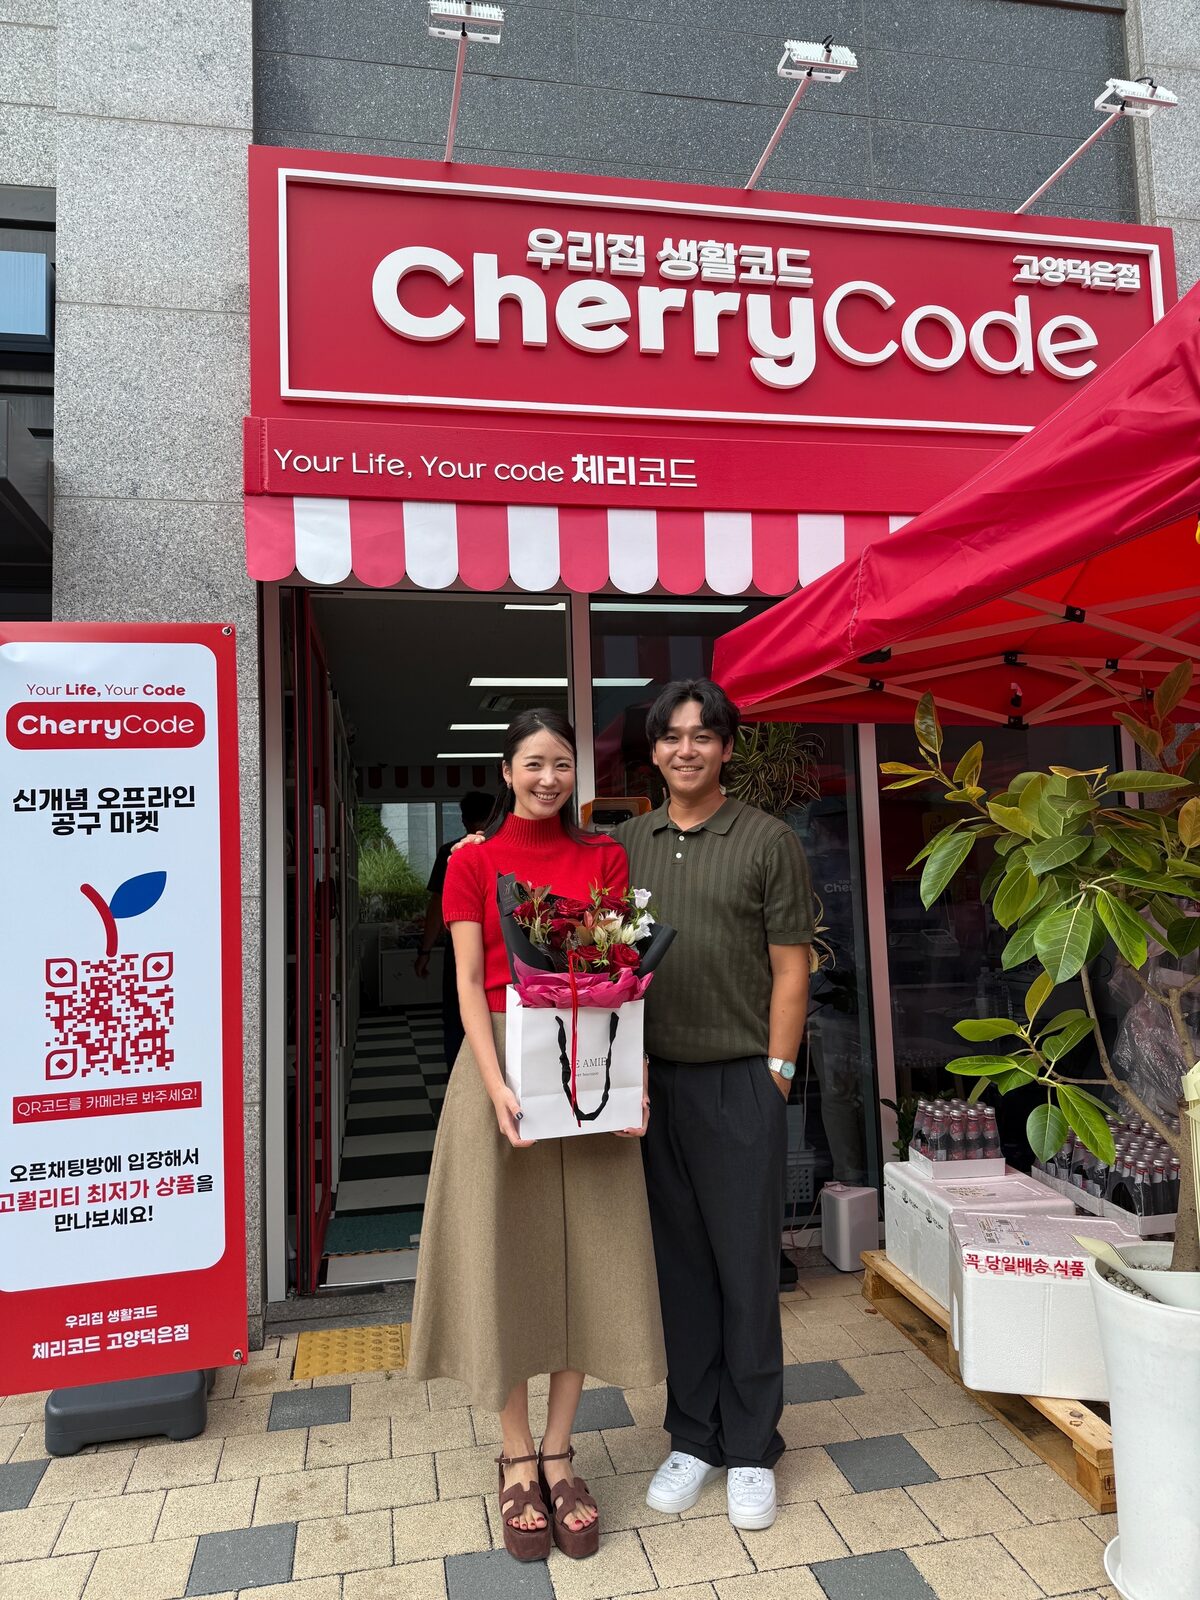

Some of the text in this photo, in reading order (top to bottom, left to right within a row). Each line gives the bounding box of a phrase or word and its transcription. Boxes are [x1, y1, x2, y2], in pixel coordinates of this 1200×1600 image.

[526, 227, 814, 288] 우리집 생활코드
[1012, 254, 1141, 293] 고양덕은점
[371, 245, 1099, 390] CherryCode
[274, 448, 698, 488] Your Life, Your code 체리코드
[26, 683, 186, 698] Your Life, Your Code
[17, 714, 195, 740] CherryCode
[12, 785, 196, 812] 신개념 오프라인
[51, 811, 159, 835] 공구 마켓
[17, 1087, 198, 1116] QR코드를 카메라로 봐주세요!
[9, 1147, 200, 1183] 오픈채팅방에 입장해서
[0, 1174, 214, 1213] 고퀄리티 최저가 상품을
[54, 1205, 154, 1232] 만나보세요!
[965, 1253, 980, 1270] 꼭
[986, 1255, 1049, 1274] 당일배송
[1054, 1259, 1086, 1277] 식품
[65, 1305, 158, 1329] 우리집 생활코드
[32, 1324, 190, 1360] 체리코드 고양덕은점
